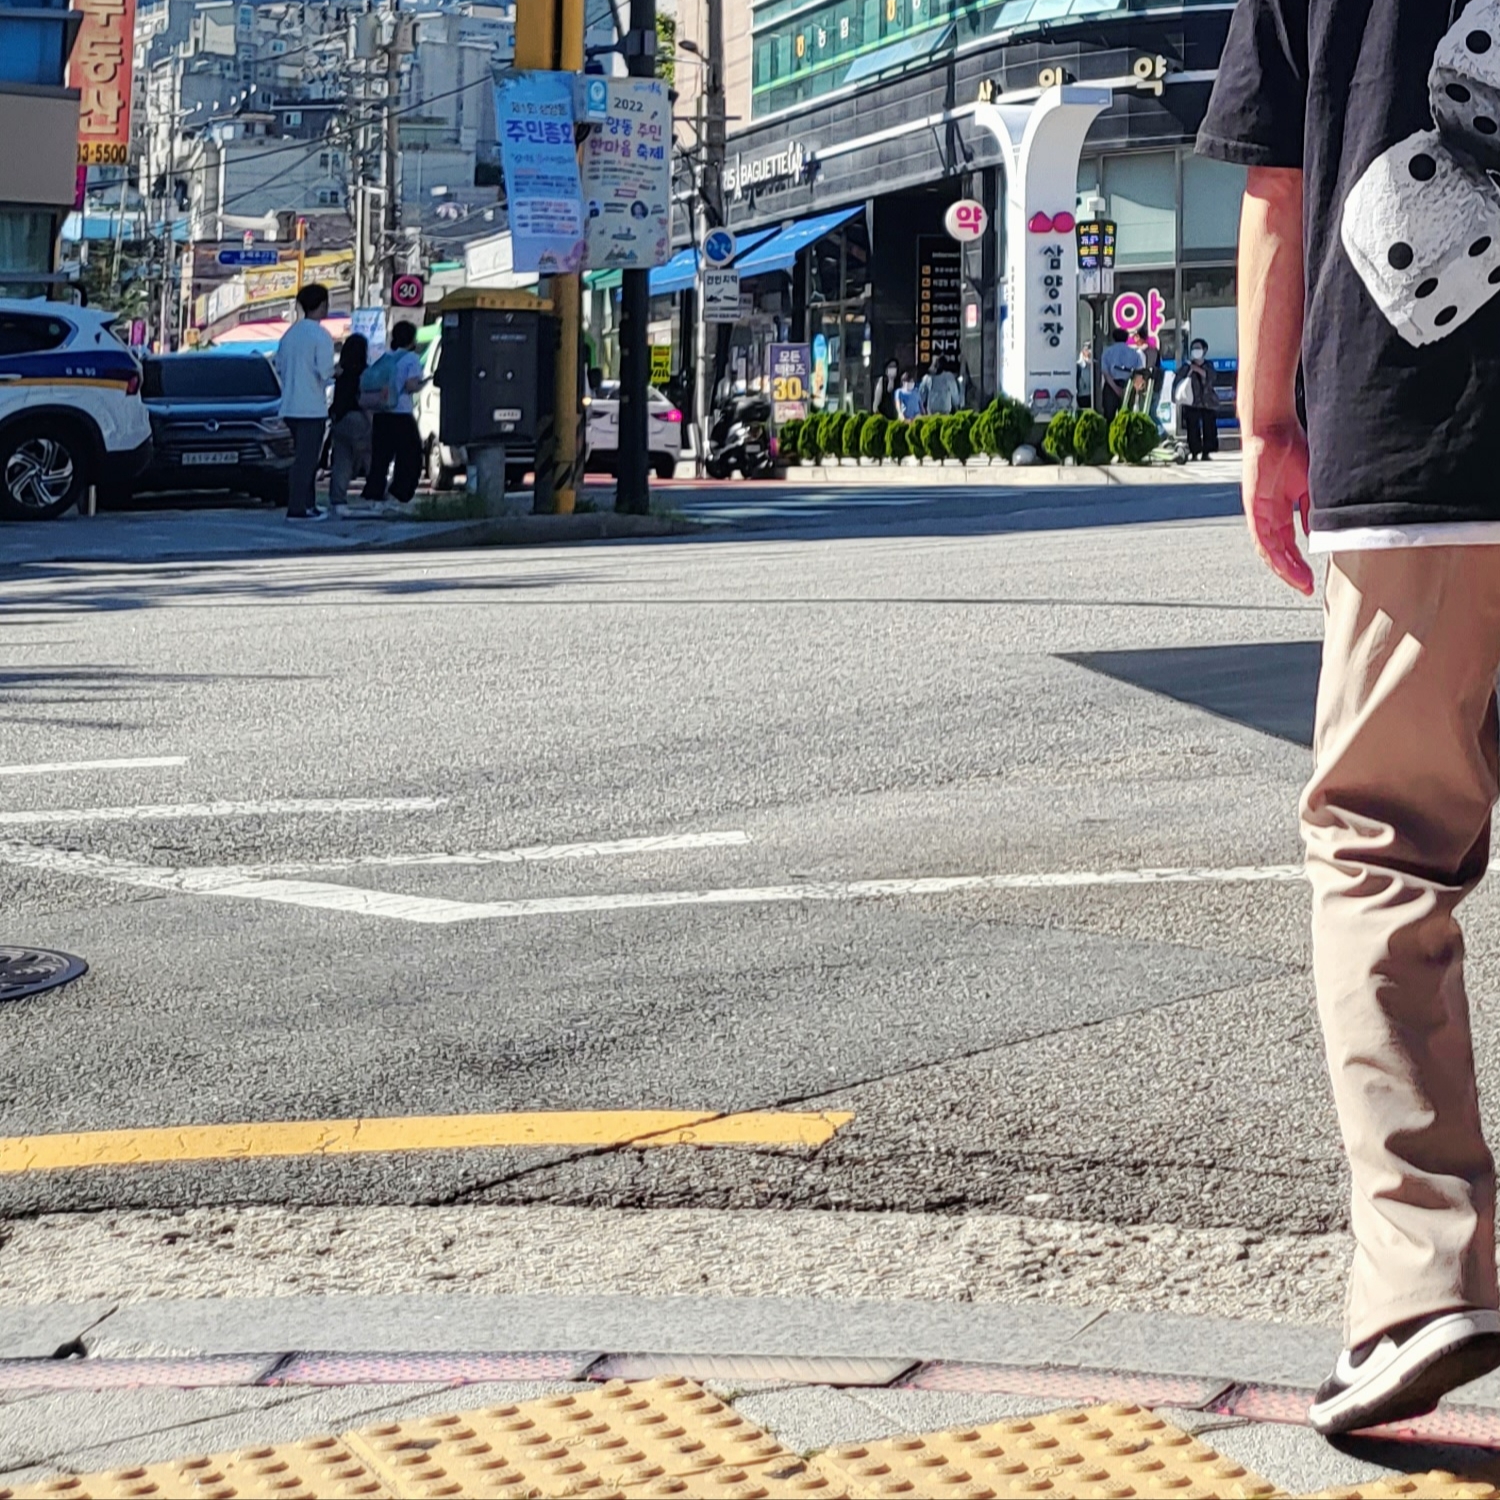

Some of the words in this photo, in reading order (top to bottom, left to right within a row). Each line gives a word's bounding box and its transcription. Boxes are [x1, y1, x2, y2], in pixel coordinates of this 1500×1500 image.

[613, 96, 645, 113] 2022
[637, 122, 663, 143] 주민
[80, 143, 128, 164] 3-5500
[590, 138, 632, 159] 한마음
[741, 151, 788, 188] BAGUETTE
[956, 205, 982, 235] 약
[399, 282, 418, 298] 30
[1042, 244, 1064, 348] 삼양시장
[931, 338, 958, 351] NH
